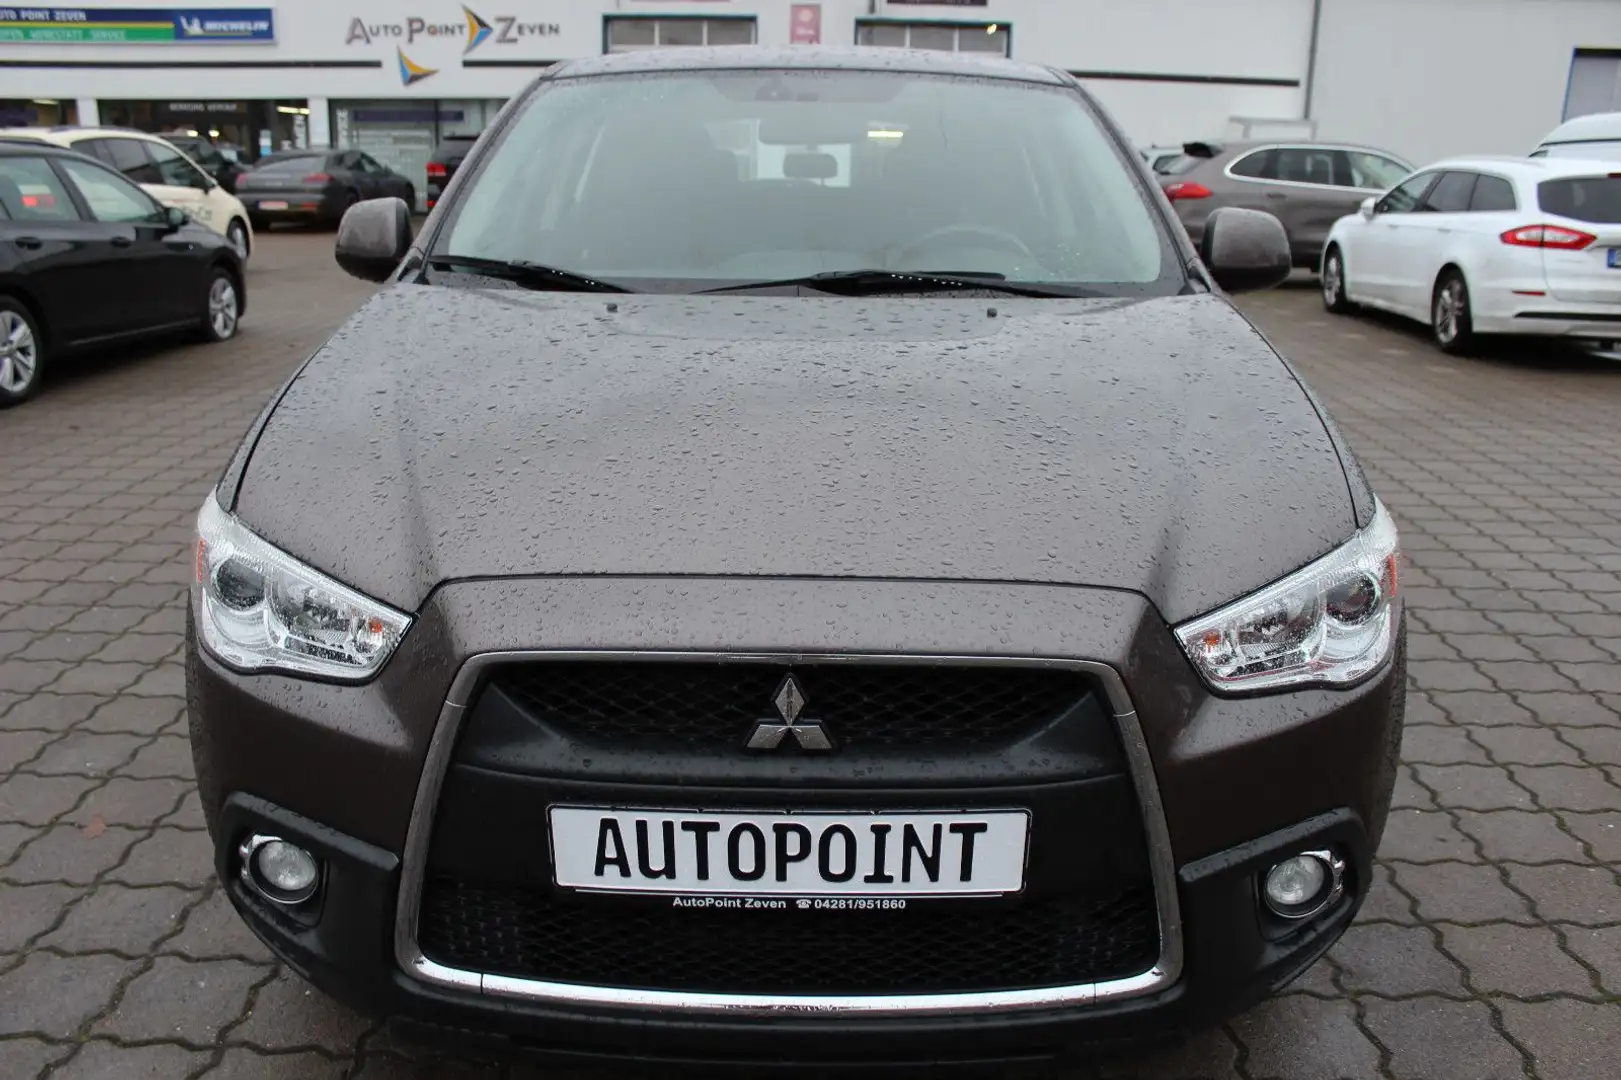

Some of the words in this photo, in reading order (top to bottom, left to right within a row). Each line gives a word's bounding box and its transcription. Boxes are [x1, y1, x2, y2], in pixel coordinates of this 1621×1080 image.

[21, 10, 49, 21] POINT
[54, 10, 87, 21] ZEVEN
[204, 21, 269, 32] MICHELIN
[407, 17, 465, 44] POINT
[495, 16, 559, 44] ZEVEN
[594, 818, 988, 883] AUTOPOINT
[672, 896, 741, 909] AutoPoint
[744, 897, 787, 909] Zeven
[814, 898, 906, 910] 04281/951860
